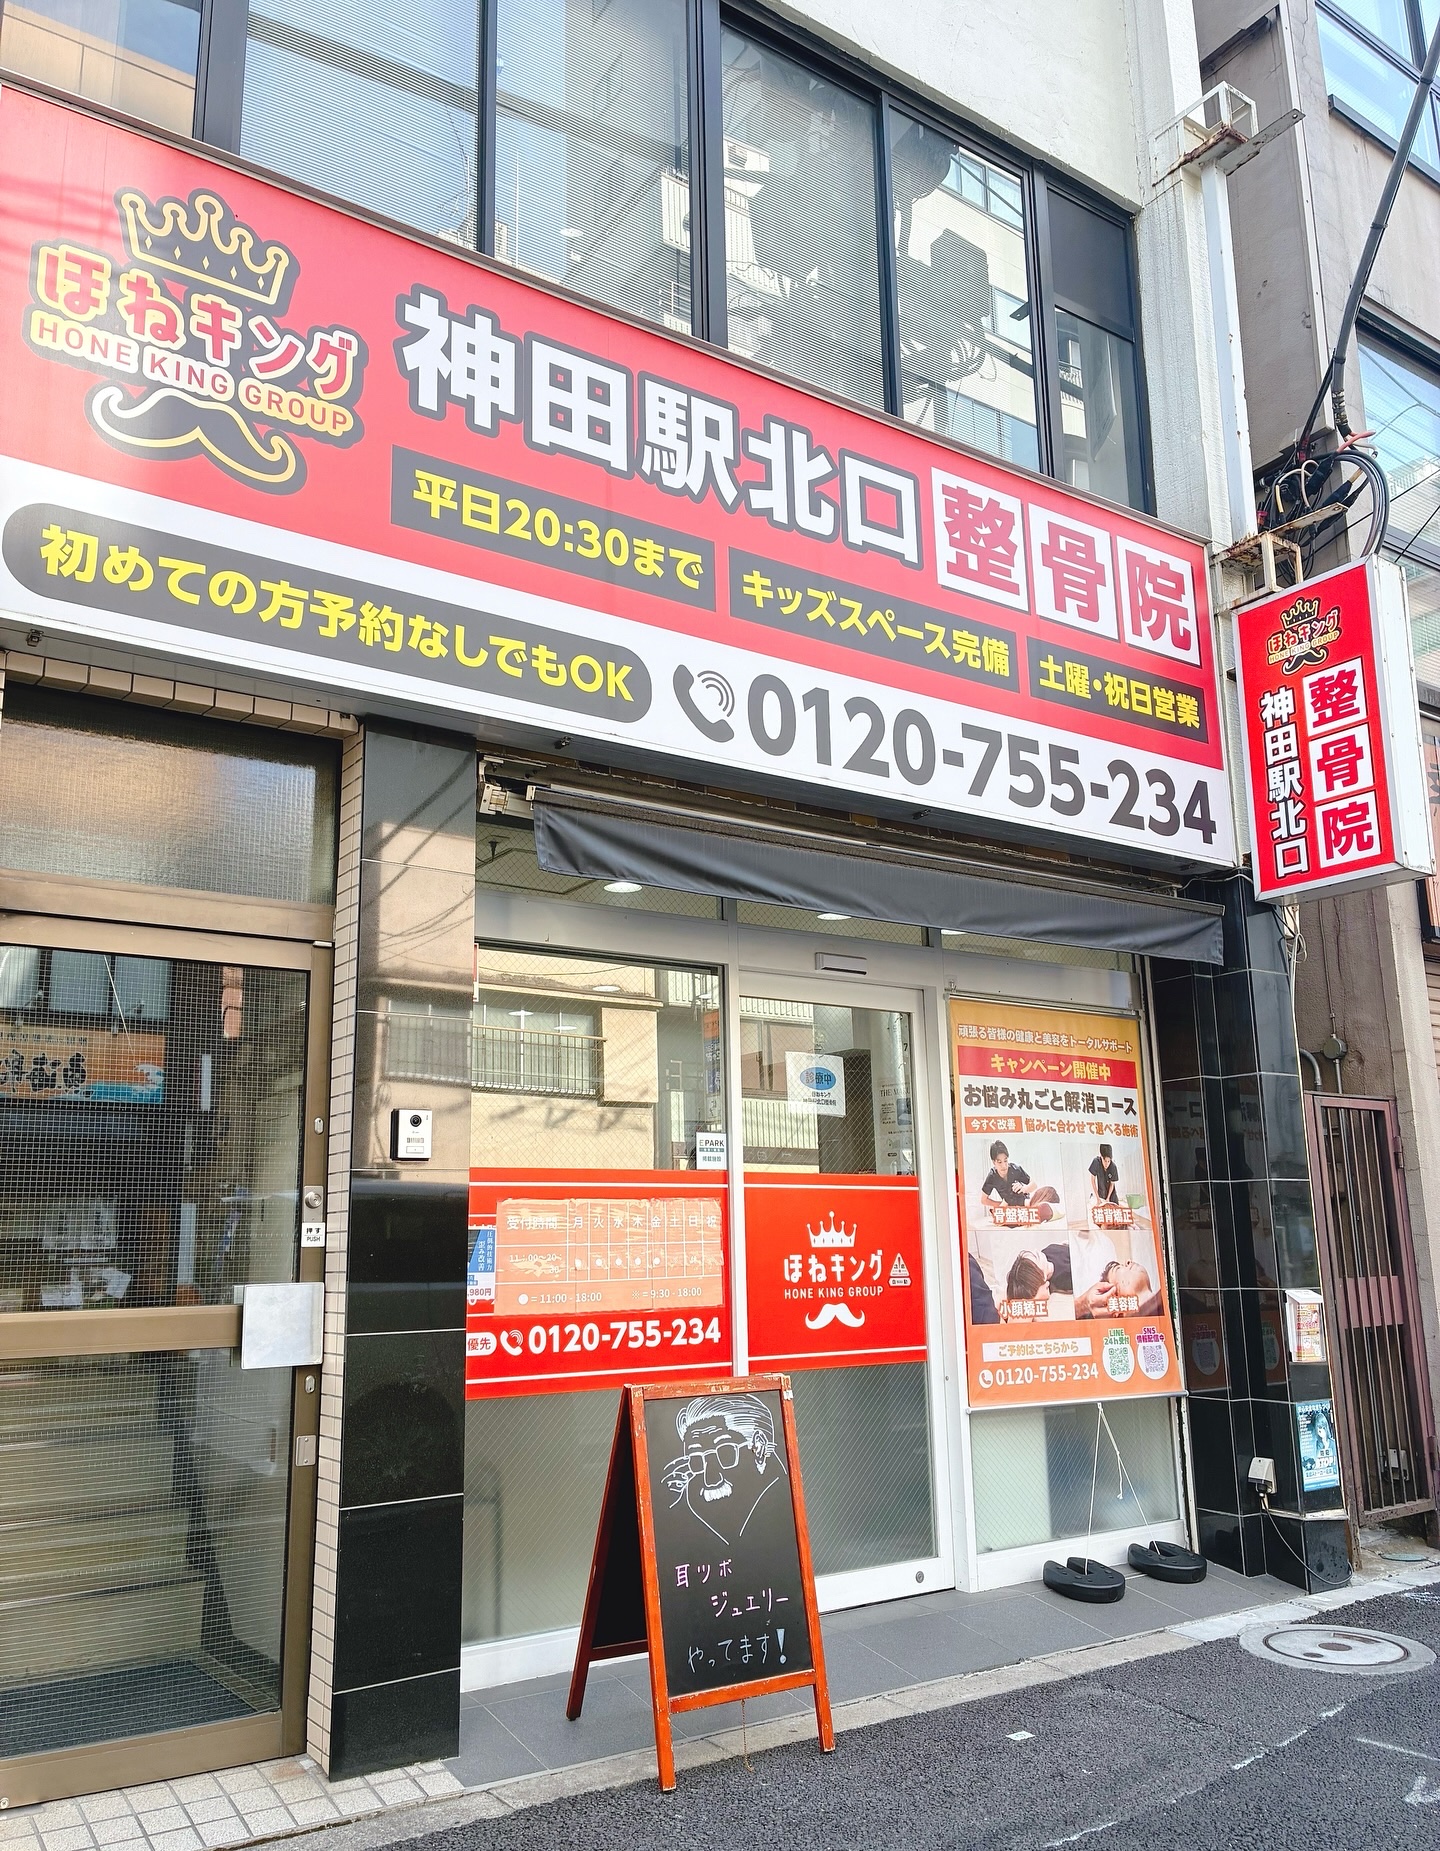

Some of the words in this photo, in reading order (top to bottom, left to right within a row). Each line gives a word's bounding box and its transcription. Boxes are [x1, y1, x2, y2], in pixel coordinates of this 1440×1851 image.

[39, 245, 355, 397] ほねキング
[37, 316, 139, 368] HONE
[150, 351, 229, 395] KING
[245, 383, 348, 430] GROUP
[401, 291, 919, 564] 神田駅北口
[941, 483, 1192, 651] 整骨院
[412, 468, 703, 590] 平日20:30まで
[40, 523, 634, 702] 初めての方予約なしでもOK
[740, 570, 1011, 678] キッズスペース完備
[1269, 610, 1338, 653] ほねキング
[1269, 650, 1290, 663] HONE
[1291, 643, 1310, 654] KING
[1312, 631, 1339, 647] GROUP
[1039, 654, 1201, 729] 土曜・祝日営業
[747, 673, 1218, 845] 0120-755-234
[1308, 668, 1375, 861] 整骨院
[1260, 687, 1309, 878] 神田駅北口
[957, 1023, 1133, 1053] 頑張る皆様の健康と美容をトータルサポート
[989, 1053, 1112, 1083] キャンペーン開催中
[963, 1083, 1138, 1117] お悩み丸ごと解消コース
[699, 1139, 725, 1148] EPARK
[970, 1118, 1017, 1132] 今すぐ改善
[1025, 1117, 1139, 1139] 悩みに合わせて選べる施術
[573, 1216, 584, 1229] 月
[593, 1216, 605, 1229] 火
[613, 1216, 625, 1229] 水
[632, 1216, 644, 1229] 木
[650, 1216, 662, 1229] 金
[689, 1215, 699, 1228] 日
[993, 1206, 1041, 1224] 骨盤矯正
[1092, 1207, 1135, 1225] 猫背矯正
[783, 1249, 884, 1284] ほねキング
[784, 1288, 815, 1299] HONE
[818, 1287, 844, 1298] KING
[848, 1286, 884, 1298] GROUP
[1000, 1299, 1049, 1318] 小顔矯正
[467, 1337, 491, 1351] 優先
[528, 1316, 721, 1354] 0120-755-234
[1109, 1328, 1125, 1338] LINE
[1142, 1327, 1156, 1335] SNS
[997, 1339, 1079, 1359] ご予約はこちらから
[995, 1361, 1099, 1387] 0120-755-234
[674, 1558, 733, 1588] 耳ツボ
[710, 1587, 789, 1618] ジュエリー
